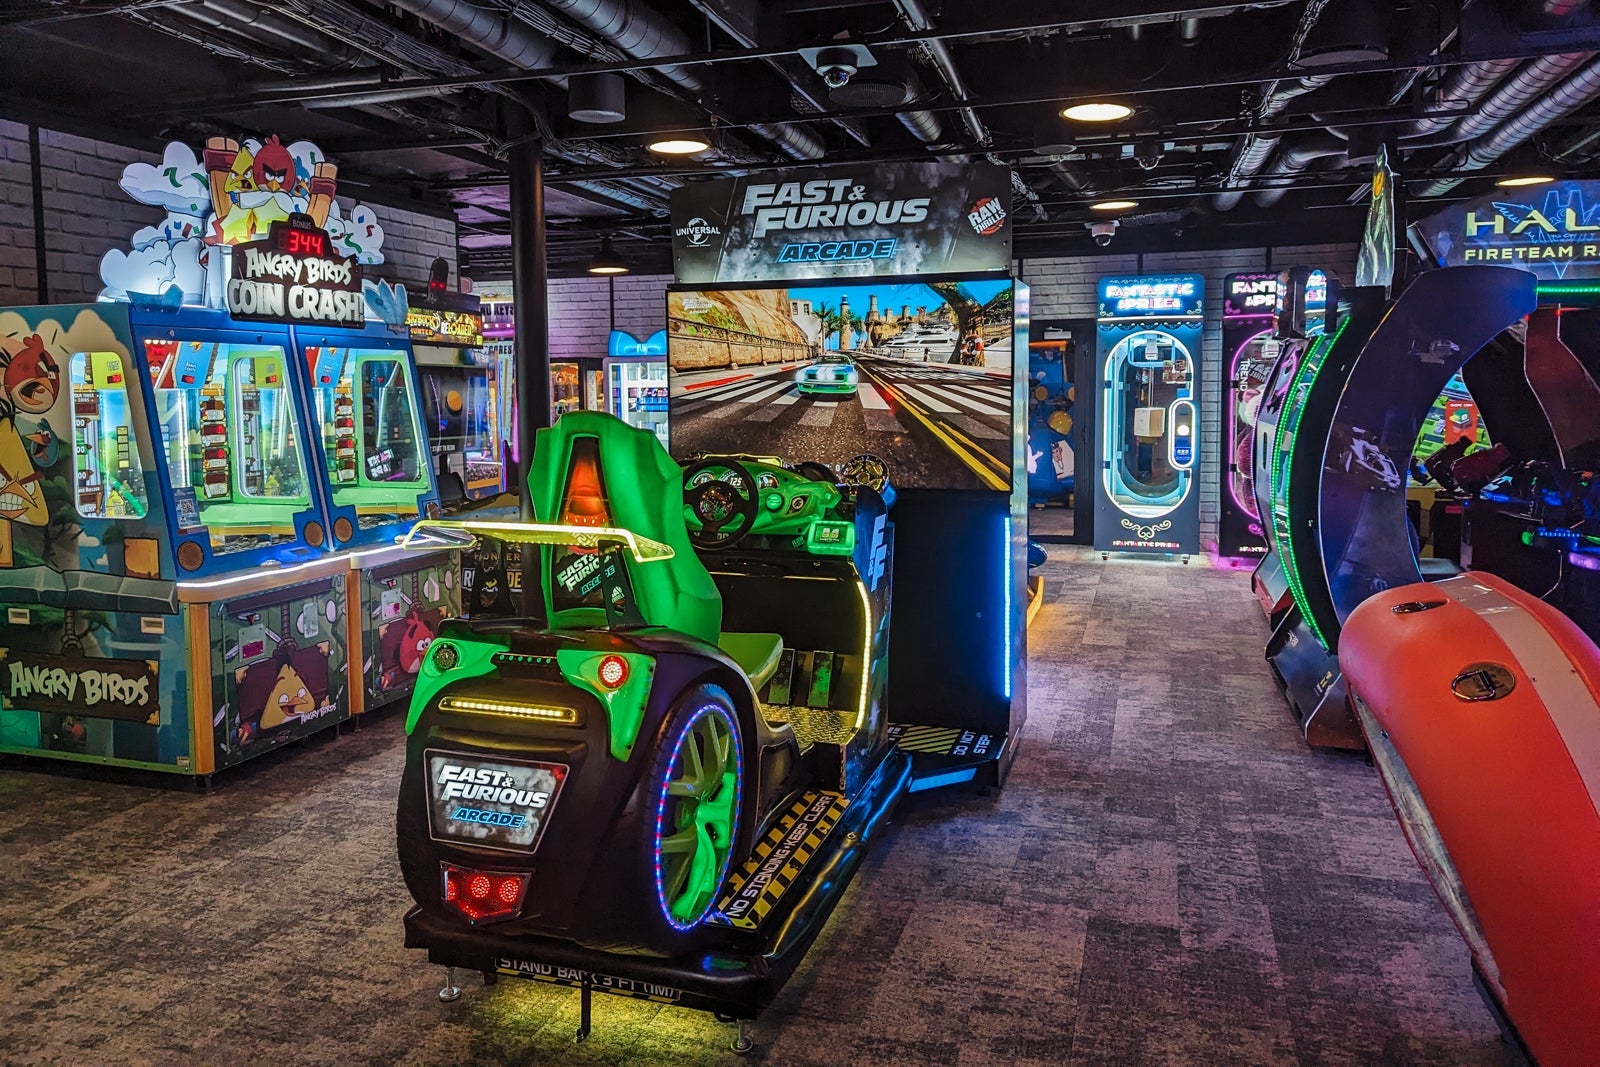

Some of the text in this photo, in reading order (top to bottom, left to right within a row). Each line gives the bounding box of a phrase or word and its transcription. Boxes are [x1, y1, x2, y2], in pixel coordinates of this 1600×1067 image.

[292, 219, 312, 230] BONUS
[752, 198, 931, 239] FURIOUS
[968, 197, 1001, 227] RAW
[974, 209, 1006, 234] THRILLS
[289, 231, 323, 255] 344
[676, 226, 721, 237] UNIVERSAL
[778, 239, 897, 263] ARCADE
[1464, 245, 1573, 261] FIRETEAM
[244, 247, 352, 286] ANGRY BIRDS
[227, 278, 365, 323] COIN CRASH!
[1106, 283, 1194, 298] FANTASTIC
[441, 321, 472, 337] RELOADED
[1241, 358, 1250, 391] TREND
[730, 477, 742, 486] 125
[8, 661, 150, 707] ANGRY BIRDS
[441, 781, 549, 809] FURIOUS
[452, 807, 526, 828] ARCADE
[726, 899, 750, 917] NO
[804, 795, 833, 823] CLEAR
[501, 958, 552, 975] STAND
[603, 976, 612, 987] 3
[618, 978, 635, 991] FT
